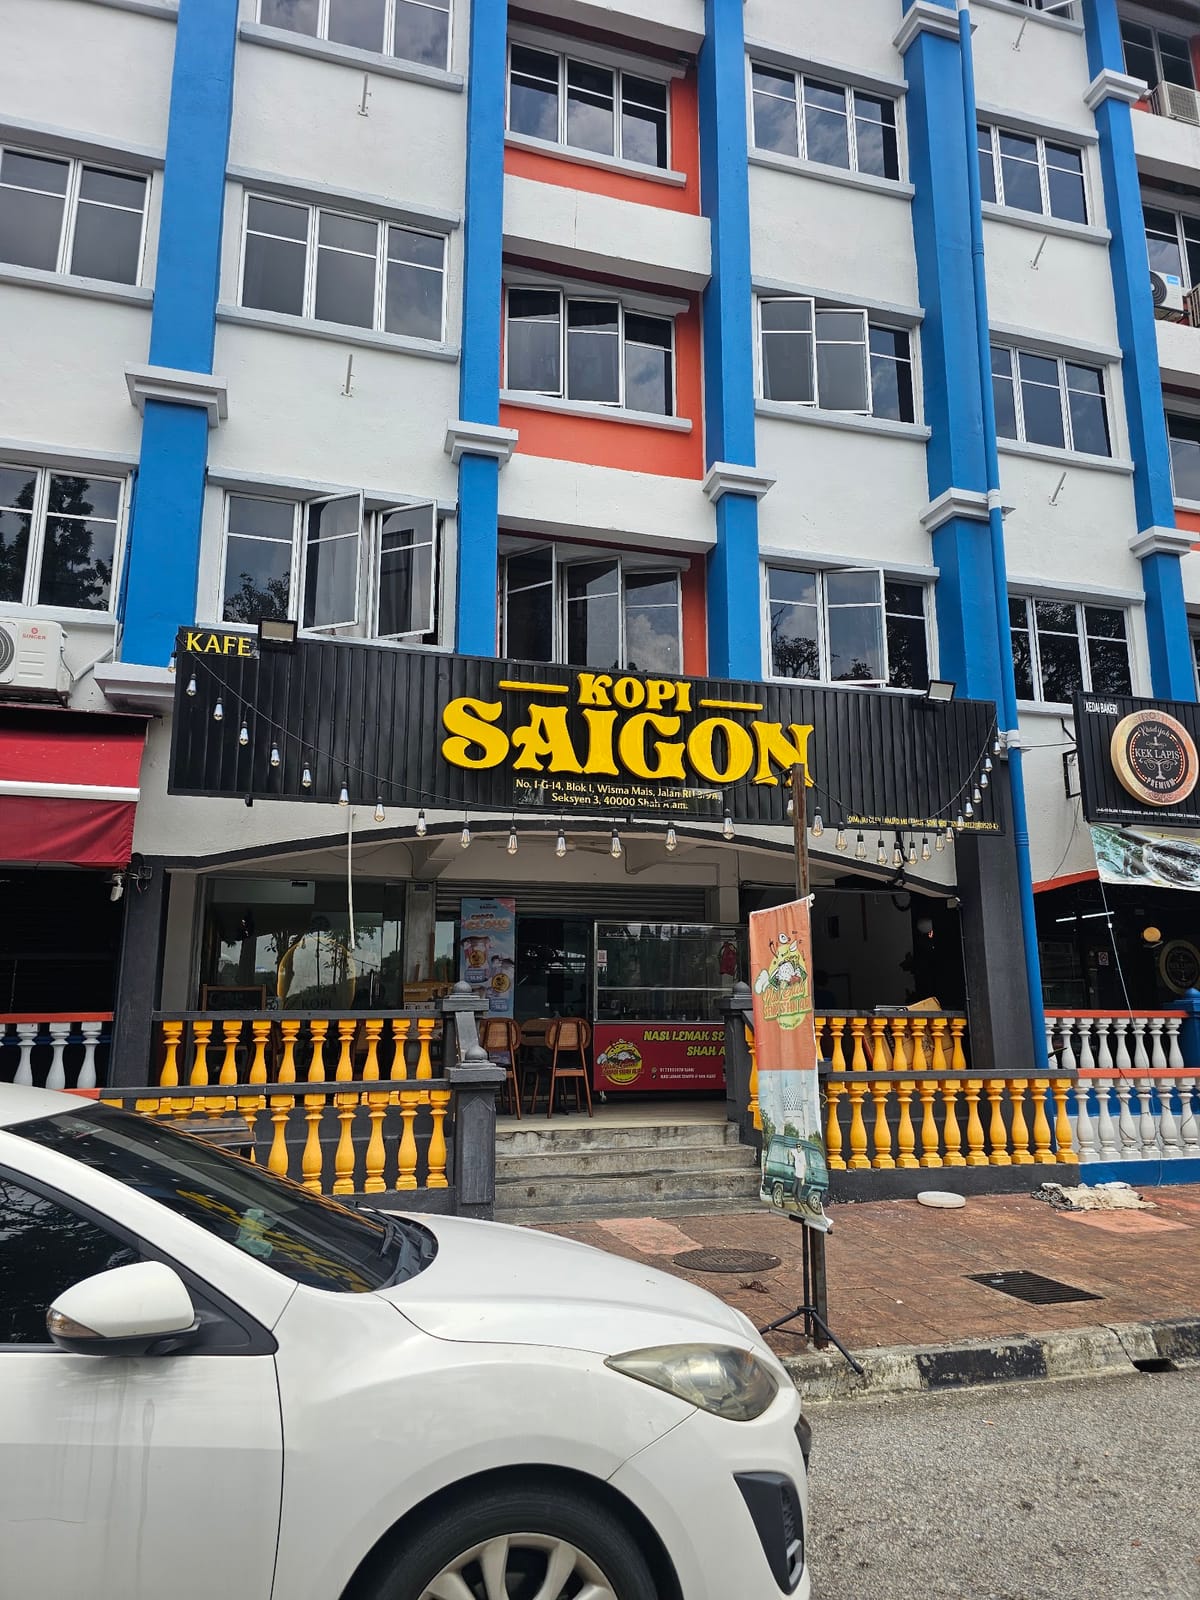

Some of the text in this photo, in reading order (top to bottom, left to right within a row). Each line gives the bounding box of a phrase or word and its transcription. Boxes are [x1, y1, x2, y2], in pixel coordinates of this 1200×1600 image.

[22, 632, 47, 640] SINGER
[186, 632, 252, 656] KAFE
[577, 672, 692, 713] KOPI
[441, 697, 815, 788] SAIGON
[1135, 748, 1180, 760] KEK LAPIS
[516, 779, 531, 788] No.
[566, 782, 587, 792] Blok
[597, 784, 629, 795] Wisma
[657, 787, 681, 798] Jalan
[1146, 777, 1176, 789] PREMIUM
[552, 793, 591, 805] Seksyen
[603, 796, 636, 806] 40000
[643, 1030, 671, 1041] NASI
[672, 1030, 710, 1041] LEMAK
[686, 1045, 717, 1057] SHAH
